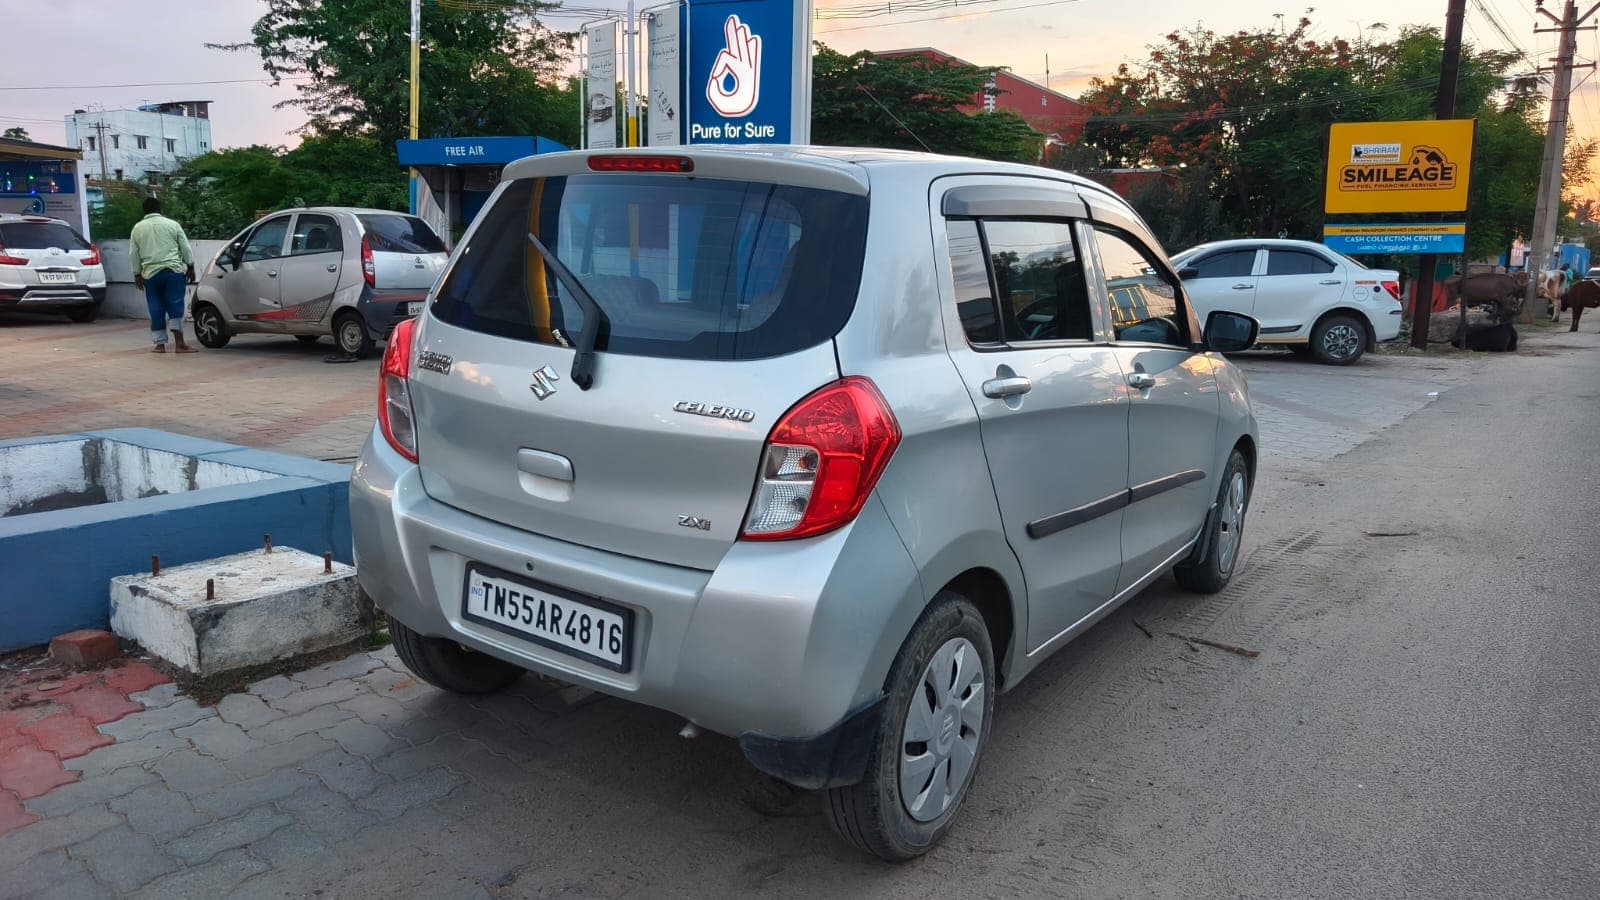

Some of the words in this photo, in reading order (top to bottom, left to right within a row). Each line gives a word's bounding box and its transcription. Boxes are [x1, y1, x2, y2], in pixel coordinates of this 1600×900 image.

[691, 123, 721, 139] Pure
[724, 122, 742, 138] for
[745, 122, 775, 138] Sure
[445, 145, 466, 156] FREE
[468, 145, 485, 156] AIR
[1363, 146, 1399, 154] SHRIRAM
[1344, 166, 1453, 183] SMILEAGE
[673, 400, 756, 422] CELERIO
[482, 581, 622, 654] TN55AR4816
